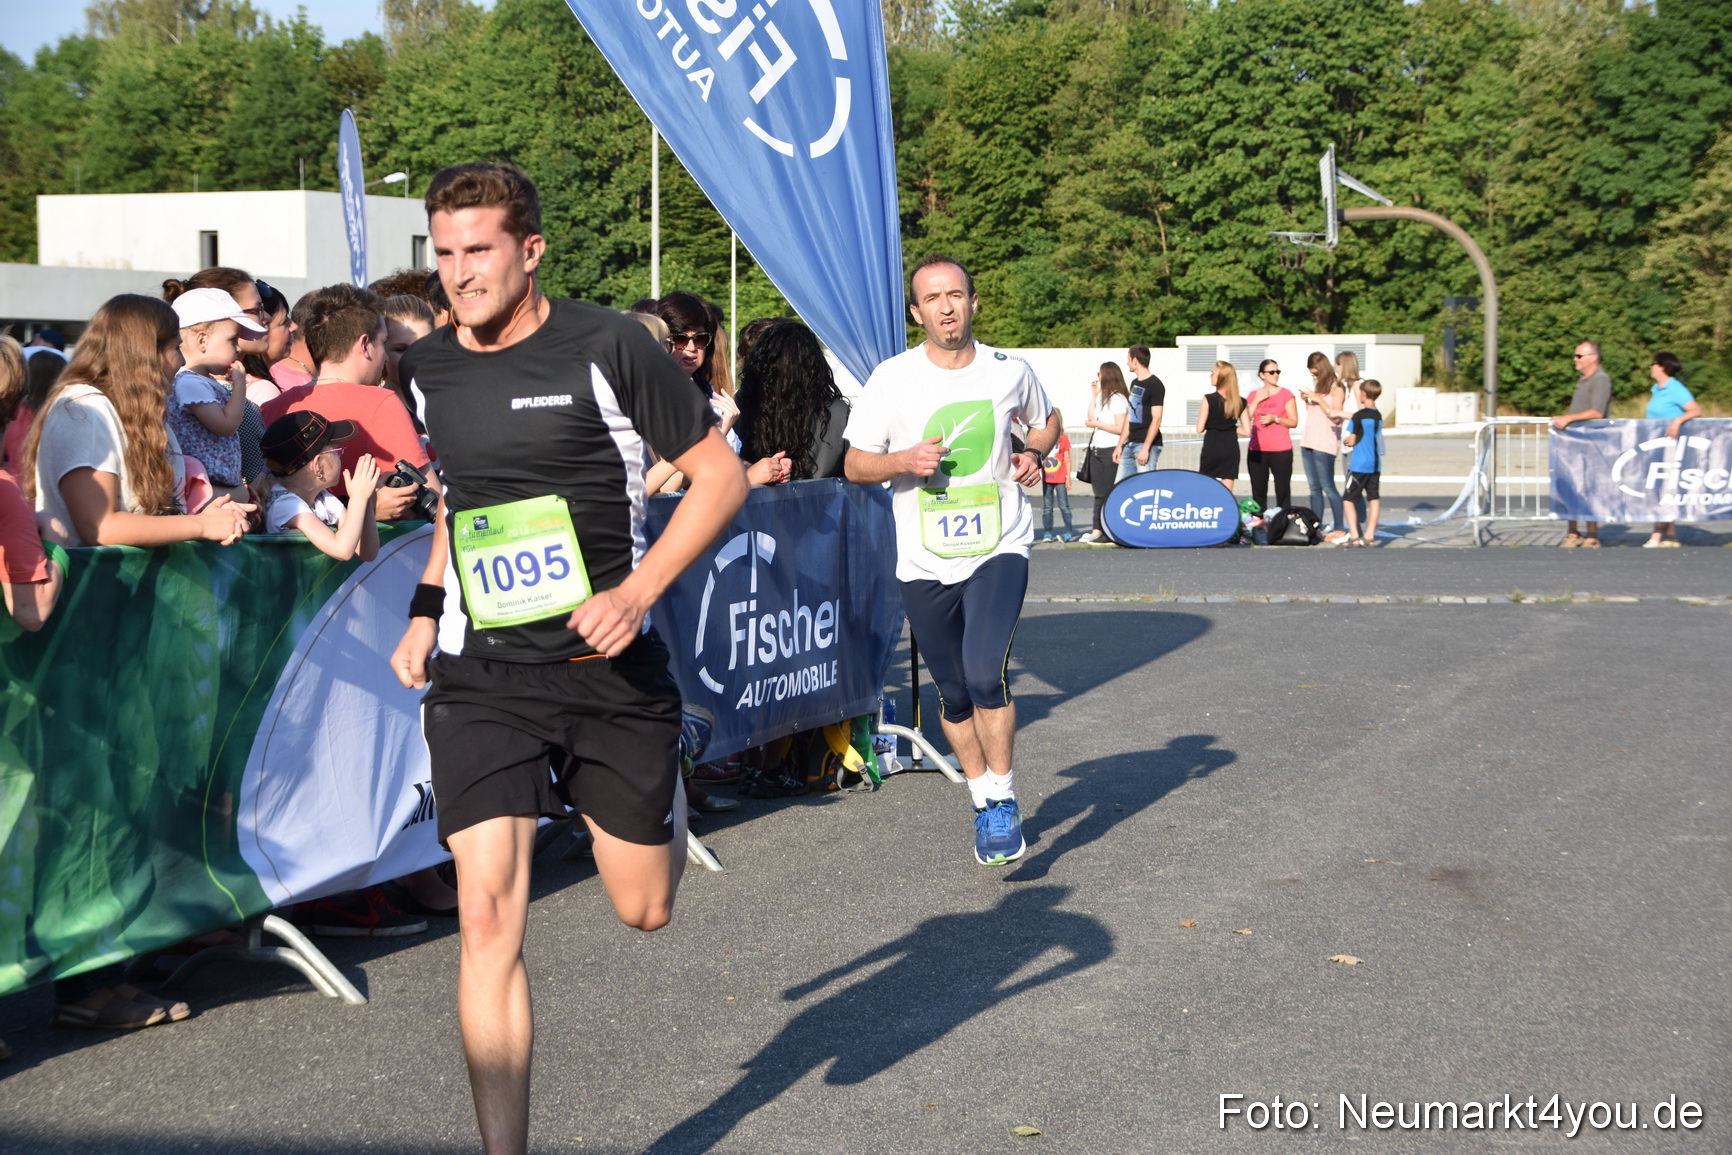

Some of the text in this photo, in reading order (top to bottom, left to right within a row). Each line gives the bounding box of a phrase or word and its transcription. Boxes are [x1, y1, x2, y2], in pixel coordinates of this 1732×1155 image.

[520, 394, 573, 409] PFLEIDERER
[1645, 462, 1732, 490] Fisc
[1140, 503, 1223, 521] Fischer
[937, 513, 982, 538] 121
[1149, 521, 1218, 530] AUTOMOBILE
[472, 543, 571, 595] 1095
[497, 597, 526, 610] Dominik
[527, 592, 554, 603] Kaiser
[736, 659, 838, 710] AUTOMOBILE
